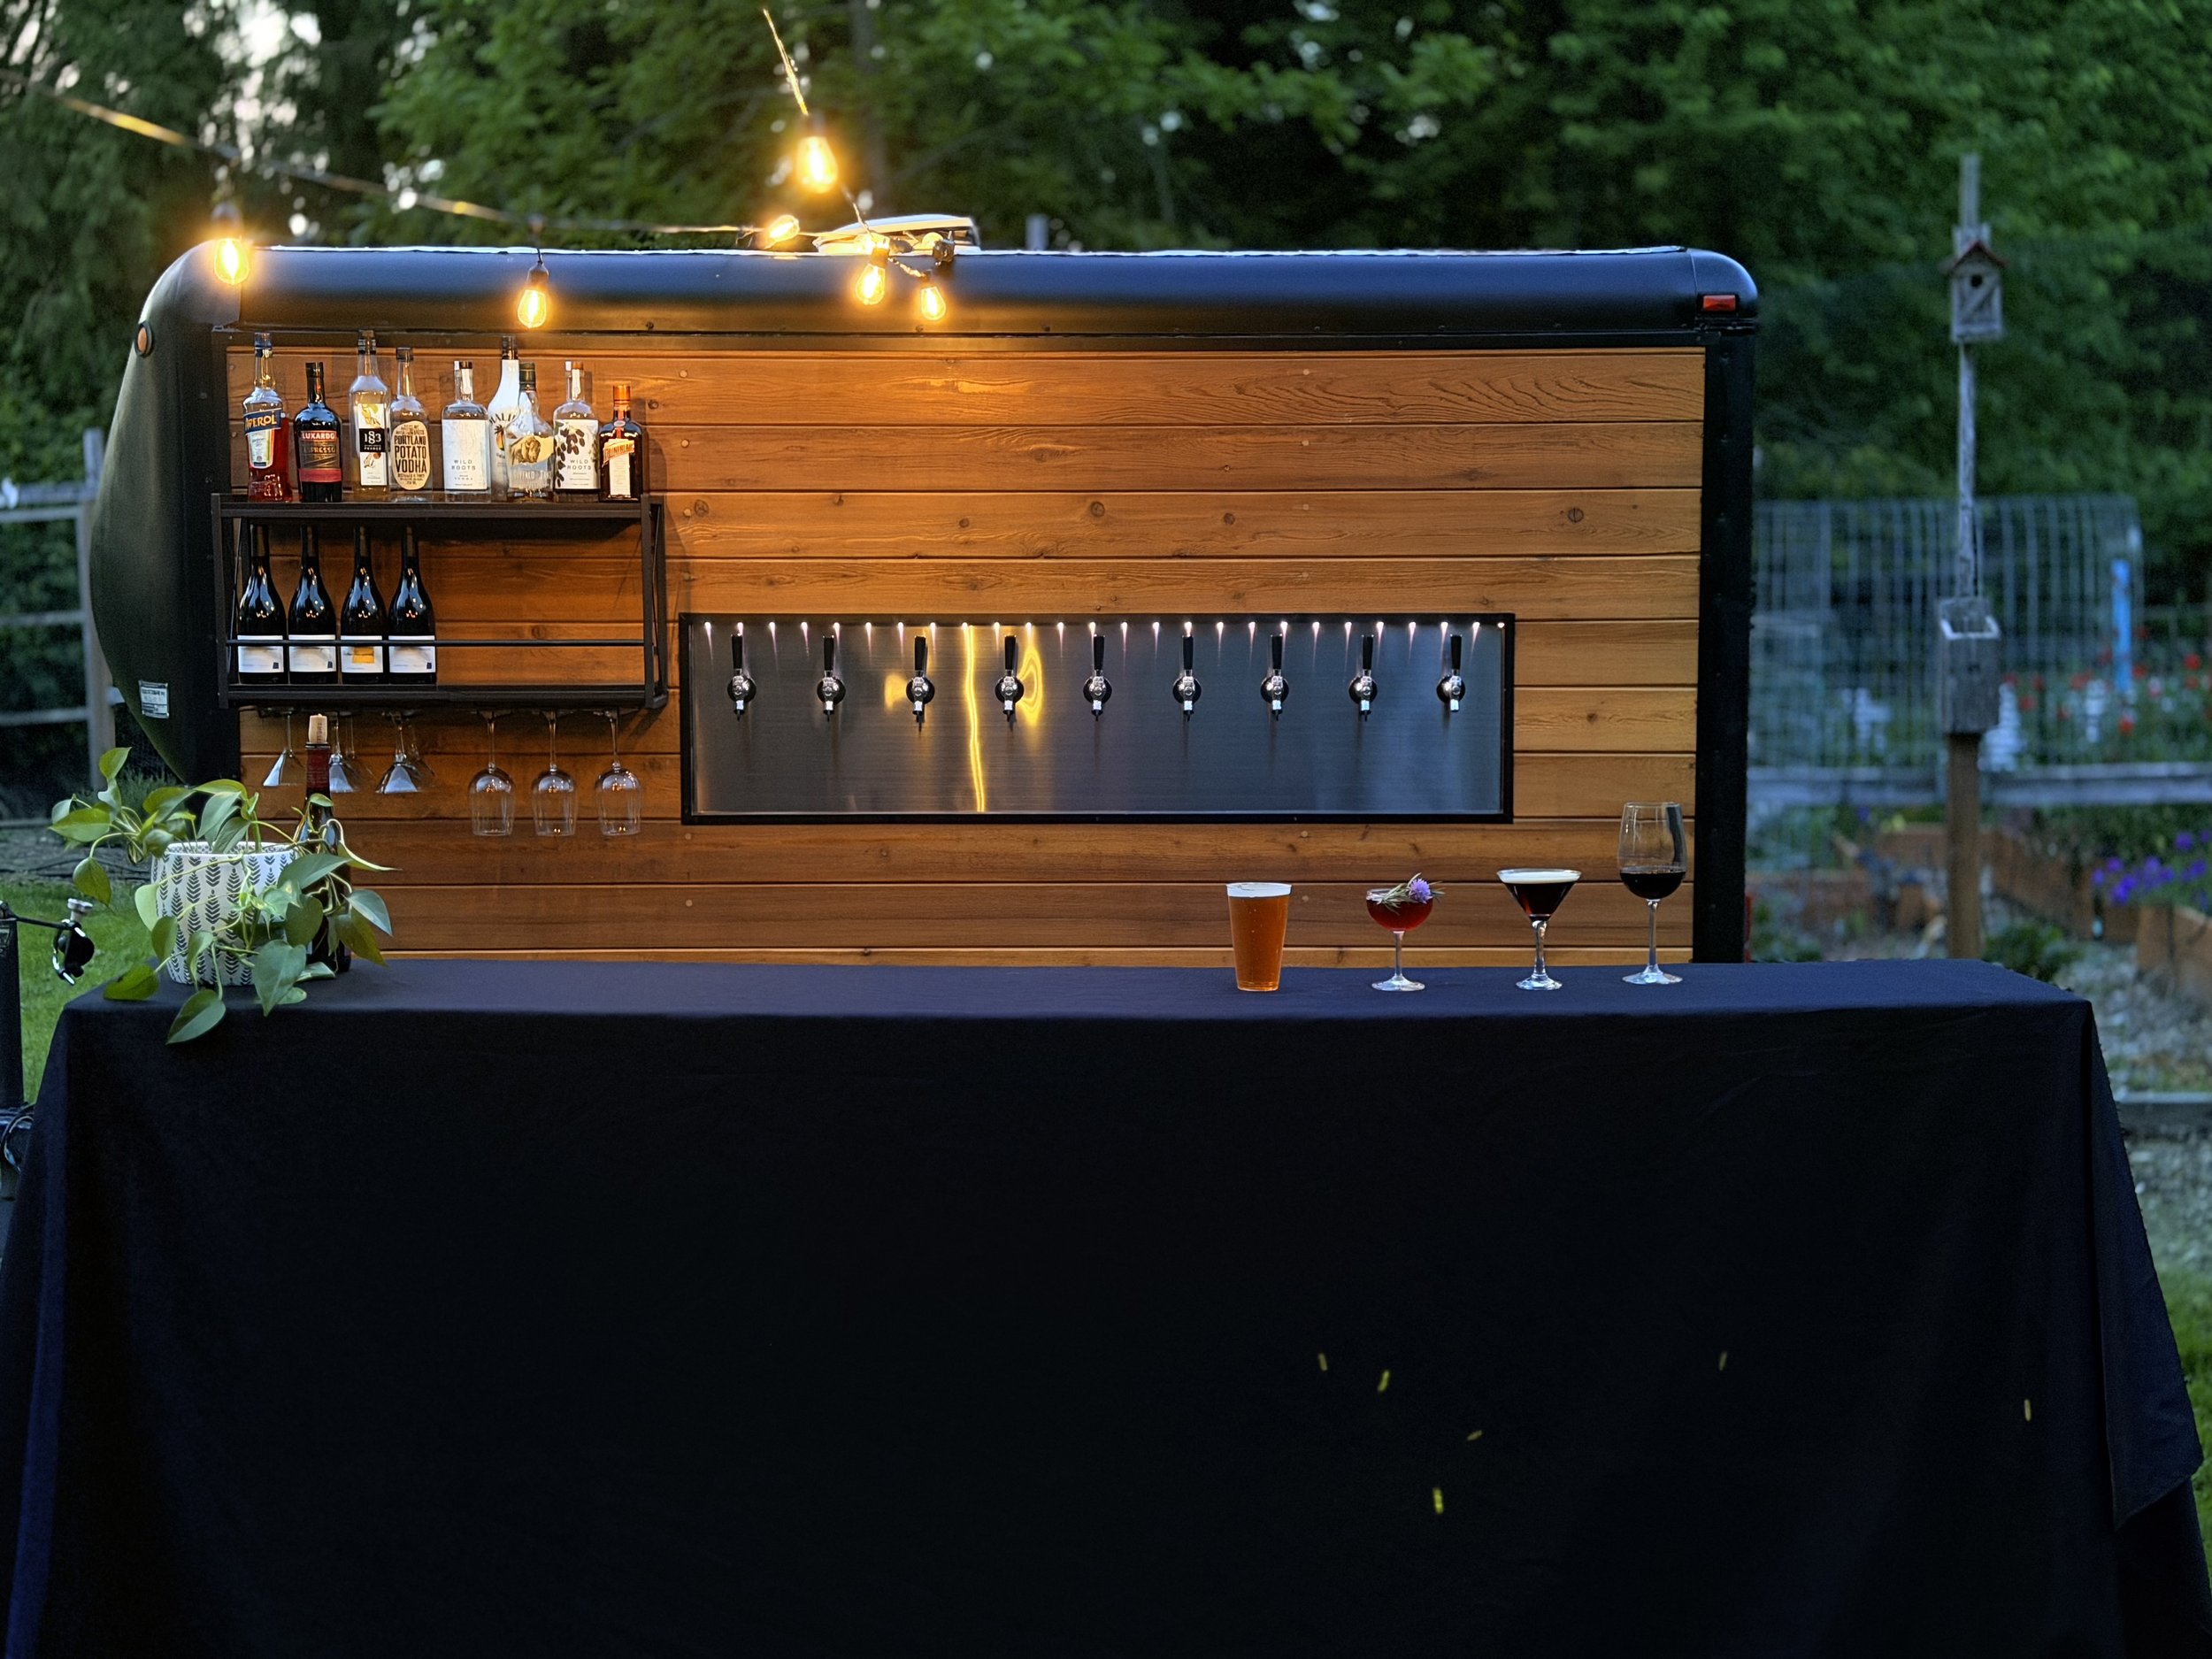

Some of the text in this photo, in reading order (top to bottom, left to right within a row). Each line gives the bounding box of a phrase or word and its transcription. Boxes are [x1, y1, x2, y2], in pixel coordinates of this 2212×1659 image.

[364, 431, 382, 444] 183
[394, 435, 426, 445] PORTLAND
[394, 445, 426, 459] POTATO
